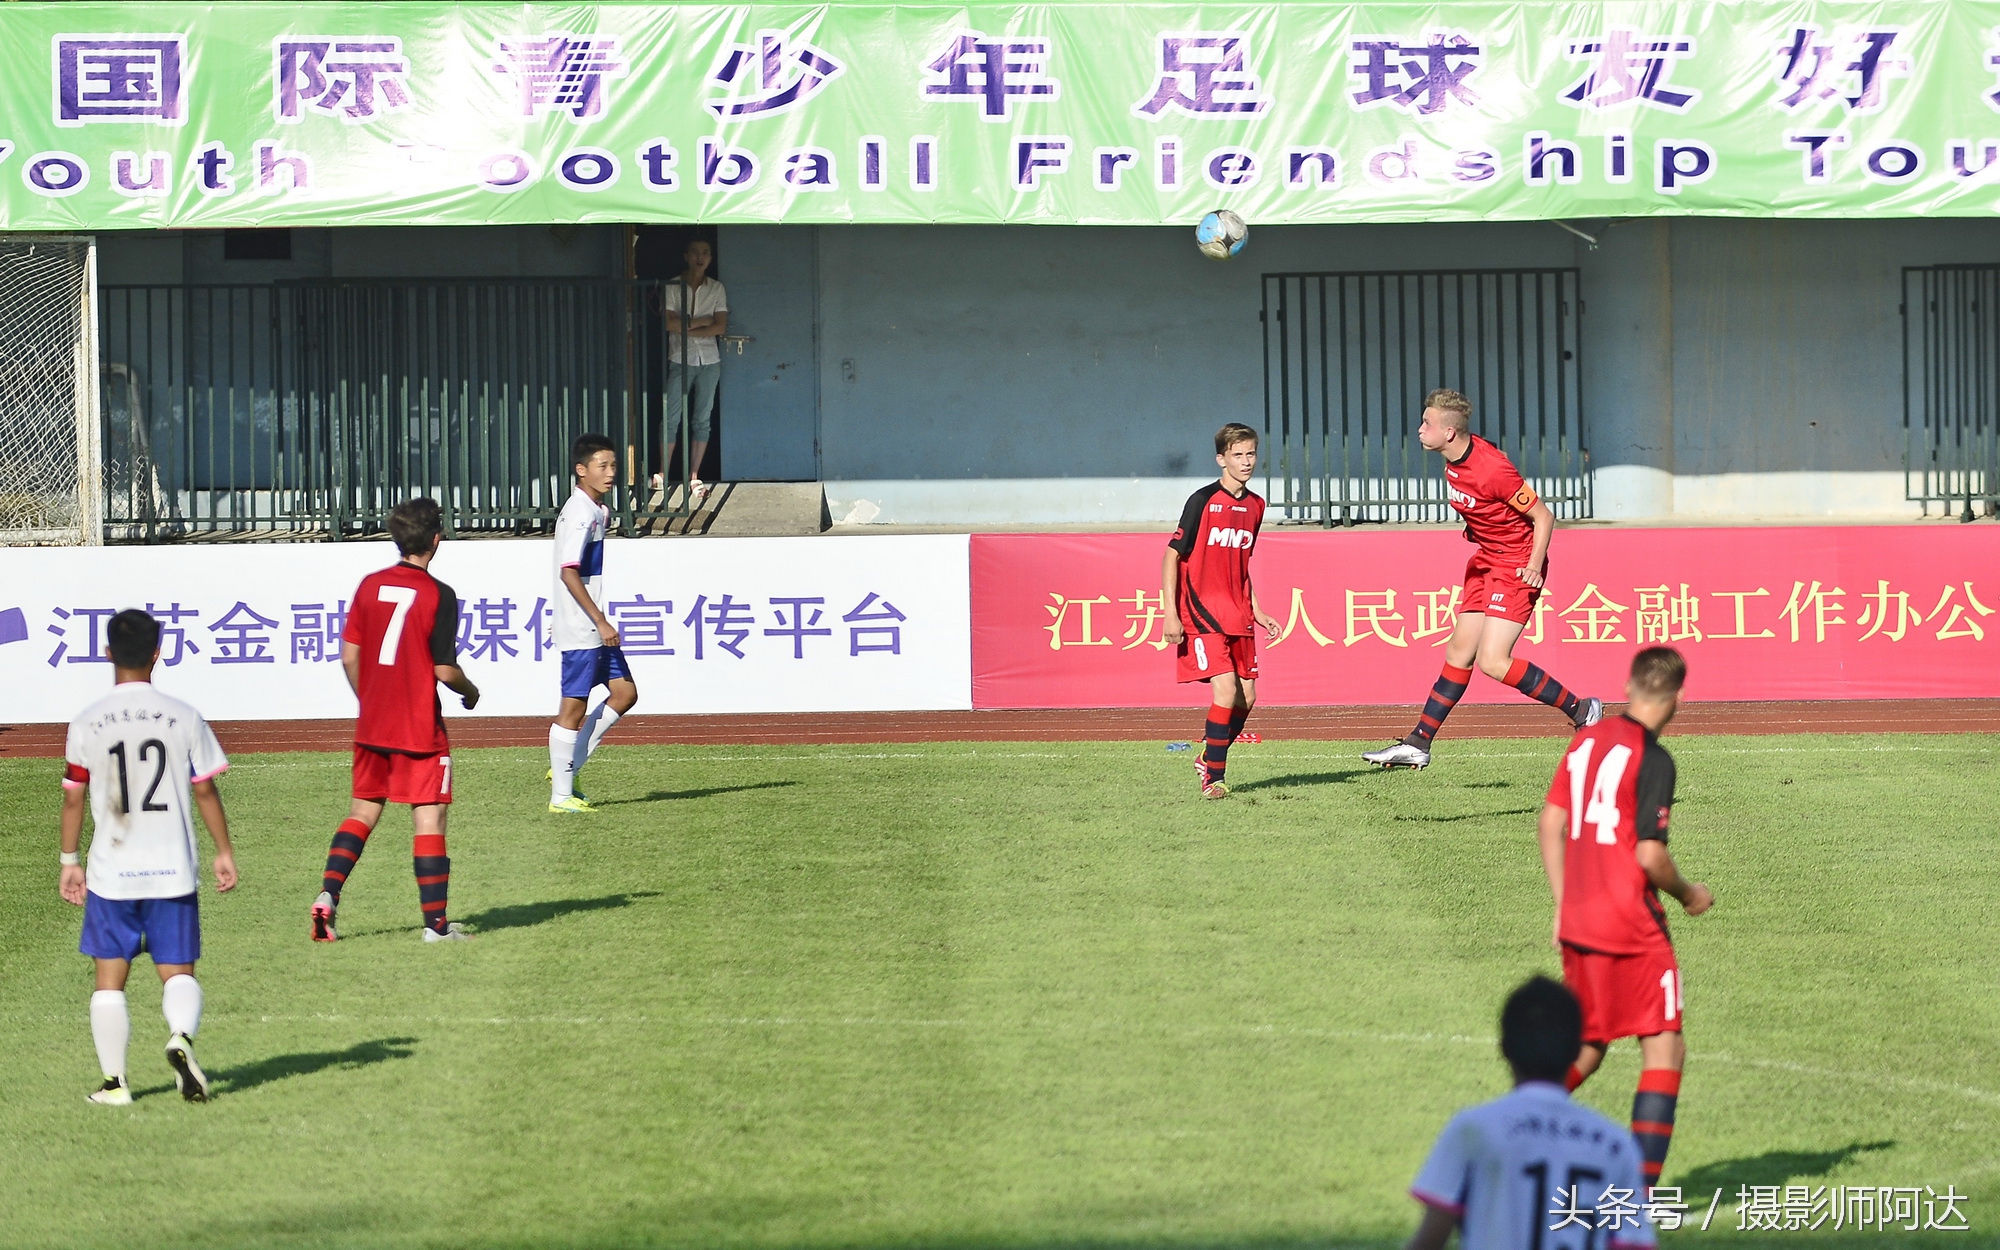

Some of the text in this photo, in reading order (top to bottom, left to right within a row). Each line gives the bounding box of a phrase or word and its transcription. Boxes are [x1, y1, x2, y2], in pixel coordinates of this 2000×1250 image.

[59, 29, 2000, 118] 国际青少年足球友好
[0, 146, 308, 190] outh
[397, 142, 932, 187] ootball
[1018, 134, 1711, 189] Friendship
[1516, 492, 1530, 506] C
[47, 592, 907, 668] 江苏金融媒宣传平台
[377, 584, 417, 667] 7
[1194, 637, 1209, 671] 8
[109, 737, 169, 814] 12
[1566, 737, 1633, 846] 14
